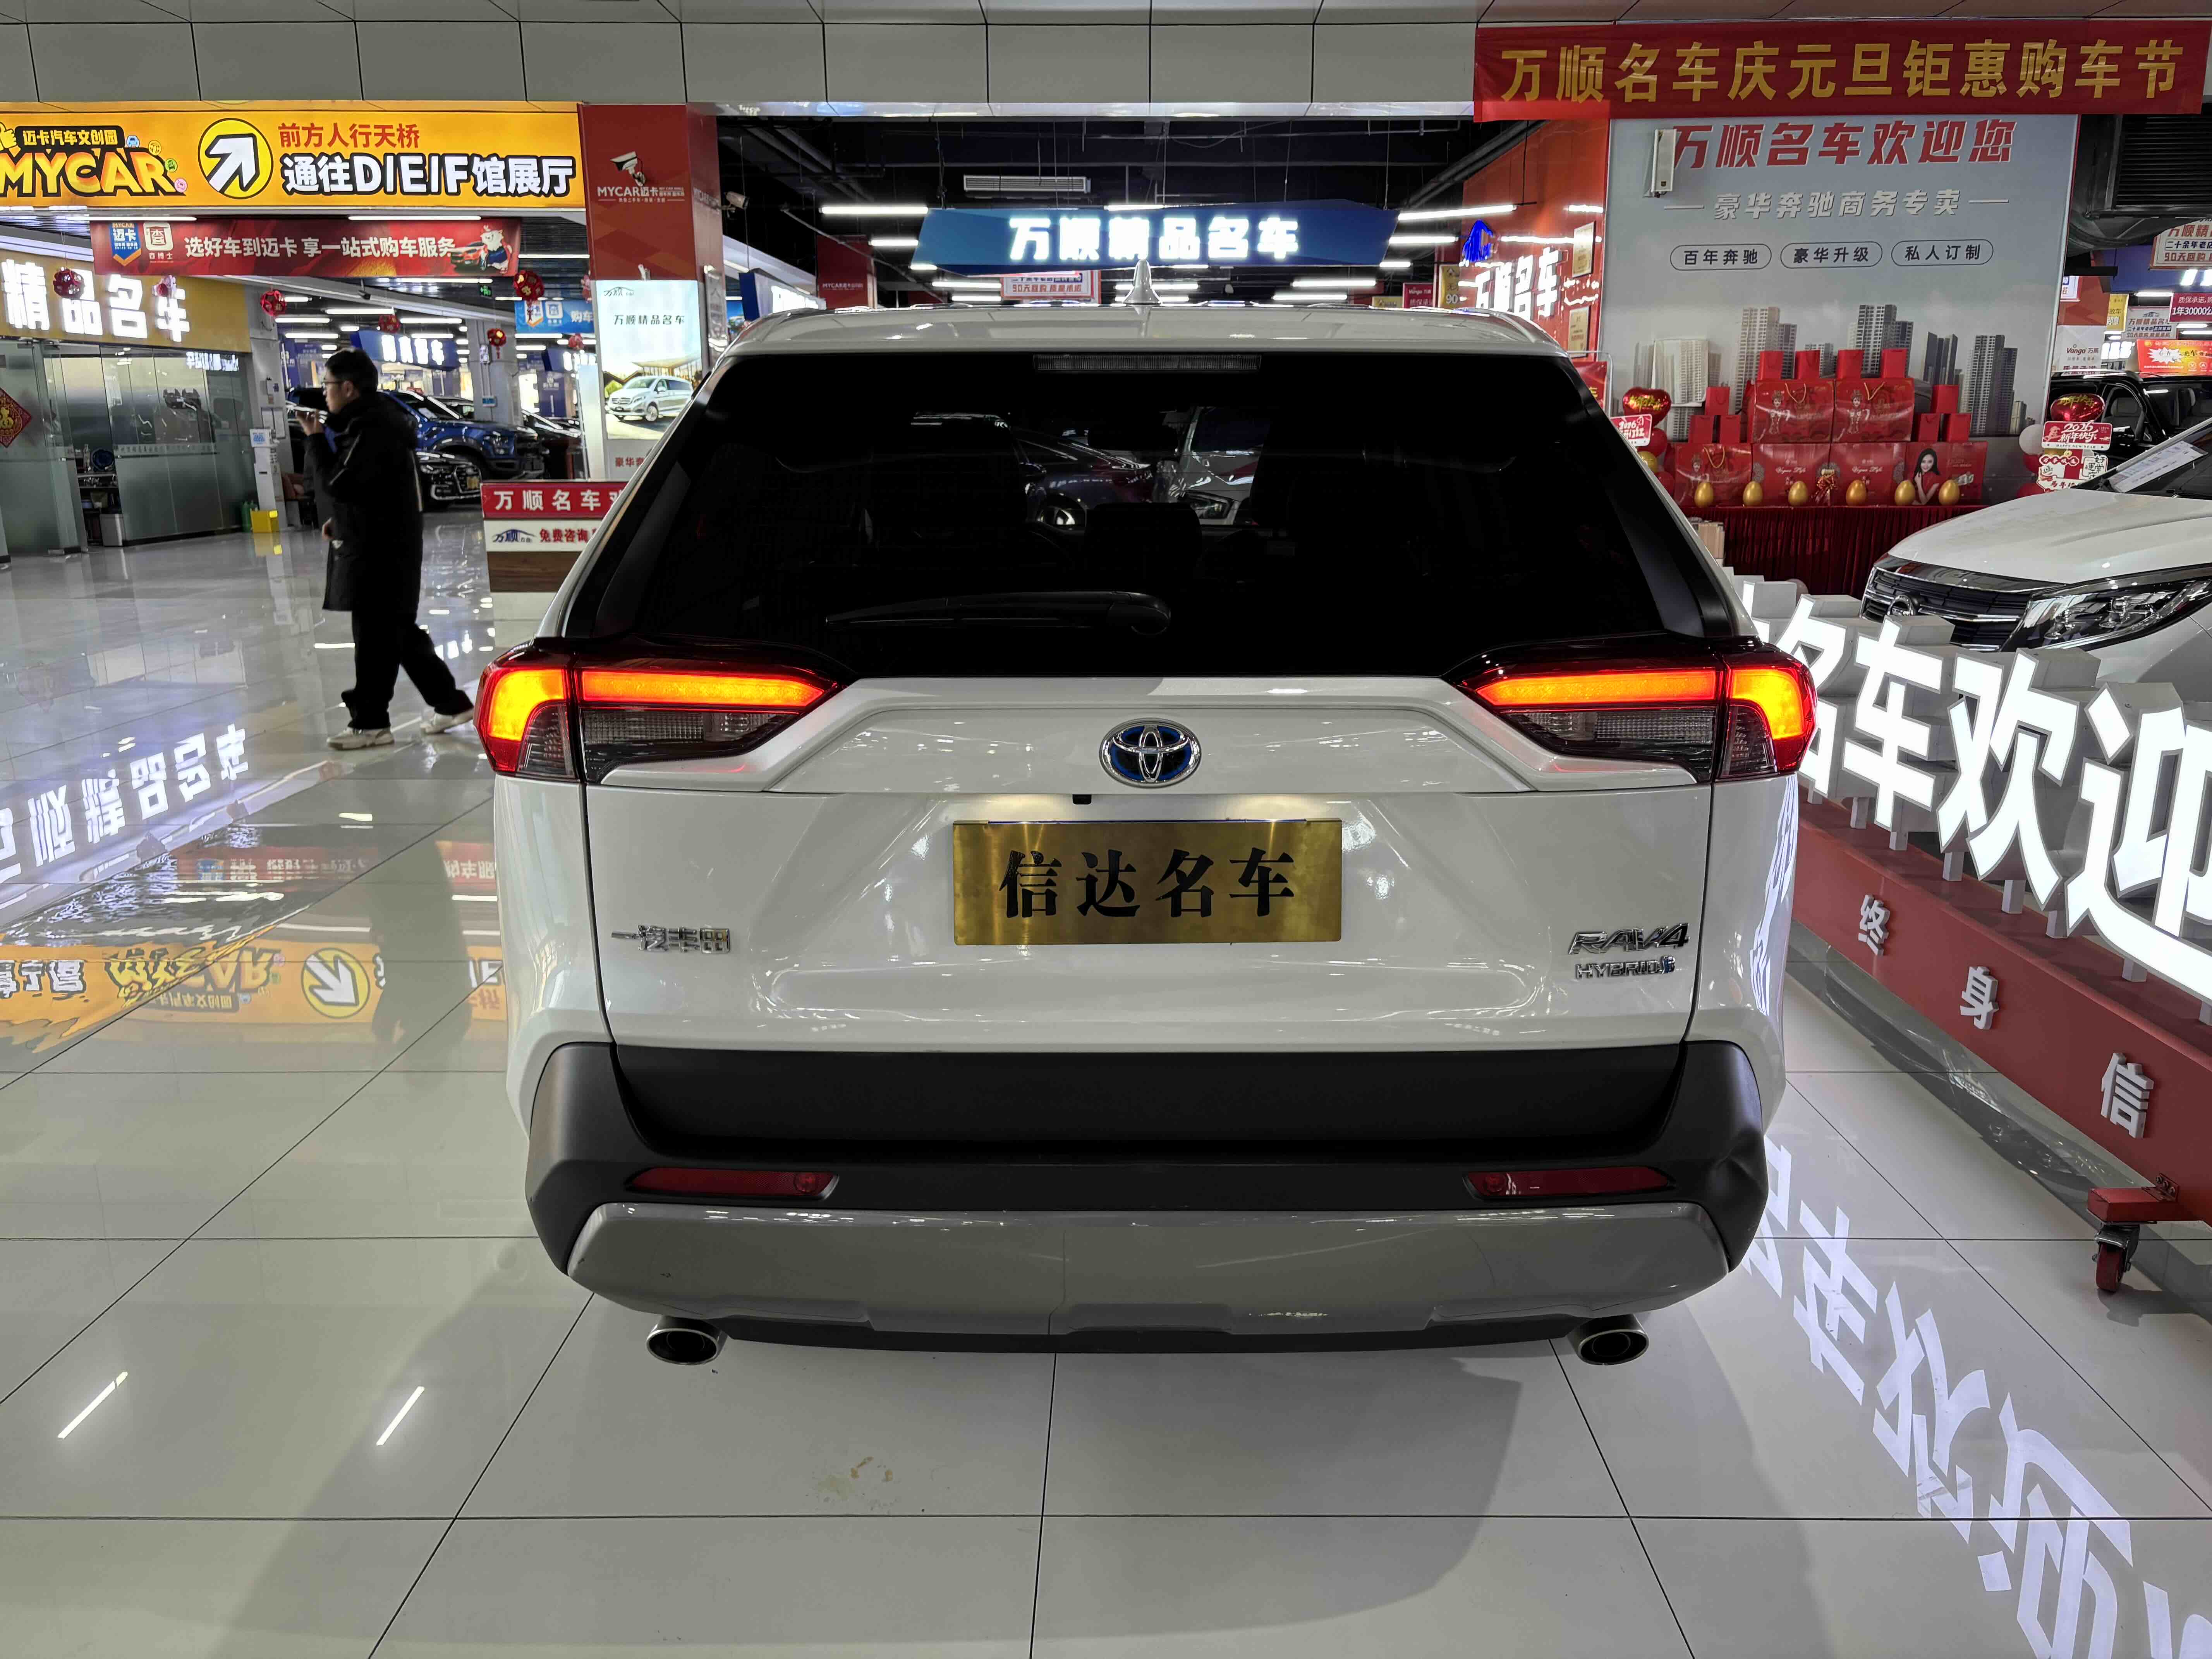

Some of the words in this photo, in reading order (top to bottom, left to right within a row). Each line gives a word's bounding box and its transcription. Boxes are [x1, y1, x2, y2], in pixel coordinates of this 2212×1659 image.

[1500, 38, 2184, 104] 万顺名车庆元旦钜惠购车节
[22, 129, 118, 146] 迈卡汽车文创园
[278, 123, 420, 148] 前方人行天桥
[1674, 119, 2017, 168] 万顺名车欢迎您
[0, 151, 177, 194] MYCAR
[283, 155, 574, 195] 通往DIEIF馆展厅
[1714, 188, 1961, 220] 豪华奔驰商务专卖
[185, 237, 297, 258] 选好车到迈卡
[303, 237, 456, 258] 享一站式购车服务
[1009, 216, 1298, 261] 万顺精品名车
[1683, 249, 1759, 265] 百年奔驰
[1793, 247, 1870, 264] 豪华升级
[1905, 244, 1981, 261] 私人订制
[1, 258, 190, 343] 精品名车
[614, 314, 685, 326] 万顺精品名车
[2057, 431, 2097, 443] 新年快乐
[2061, 420, 2099, 433] 2026
[539, 528, 598, 543] 免费咨询
[999, 847, 1295, 918] 信达名车
[611, 924, 731, 954] 一汽丰田
[1568, 922, 1691, 955] RAV4
